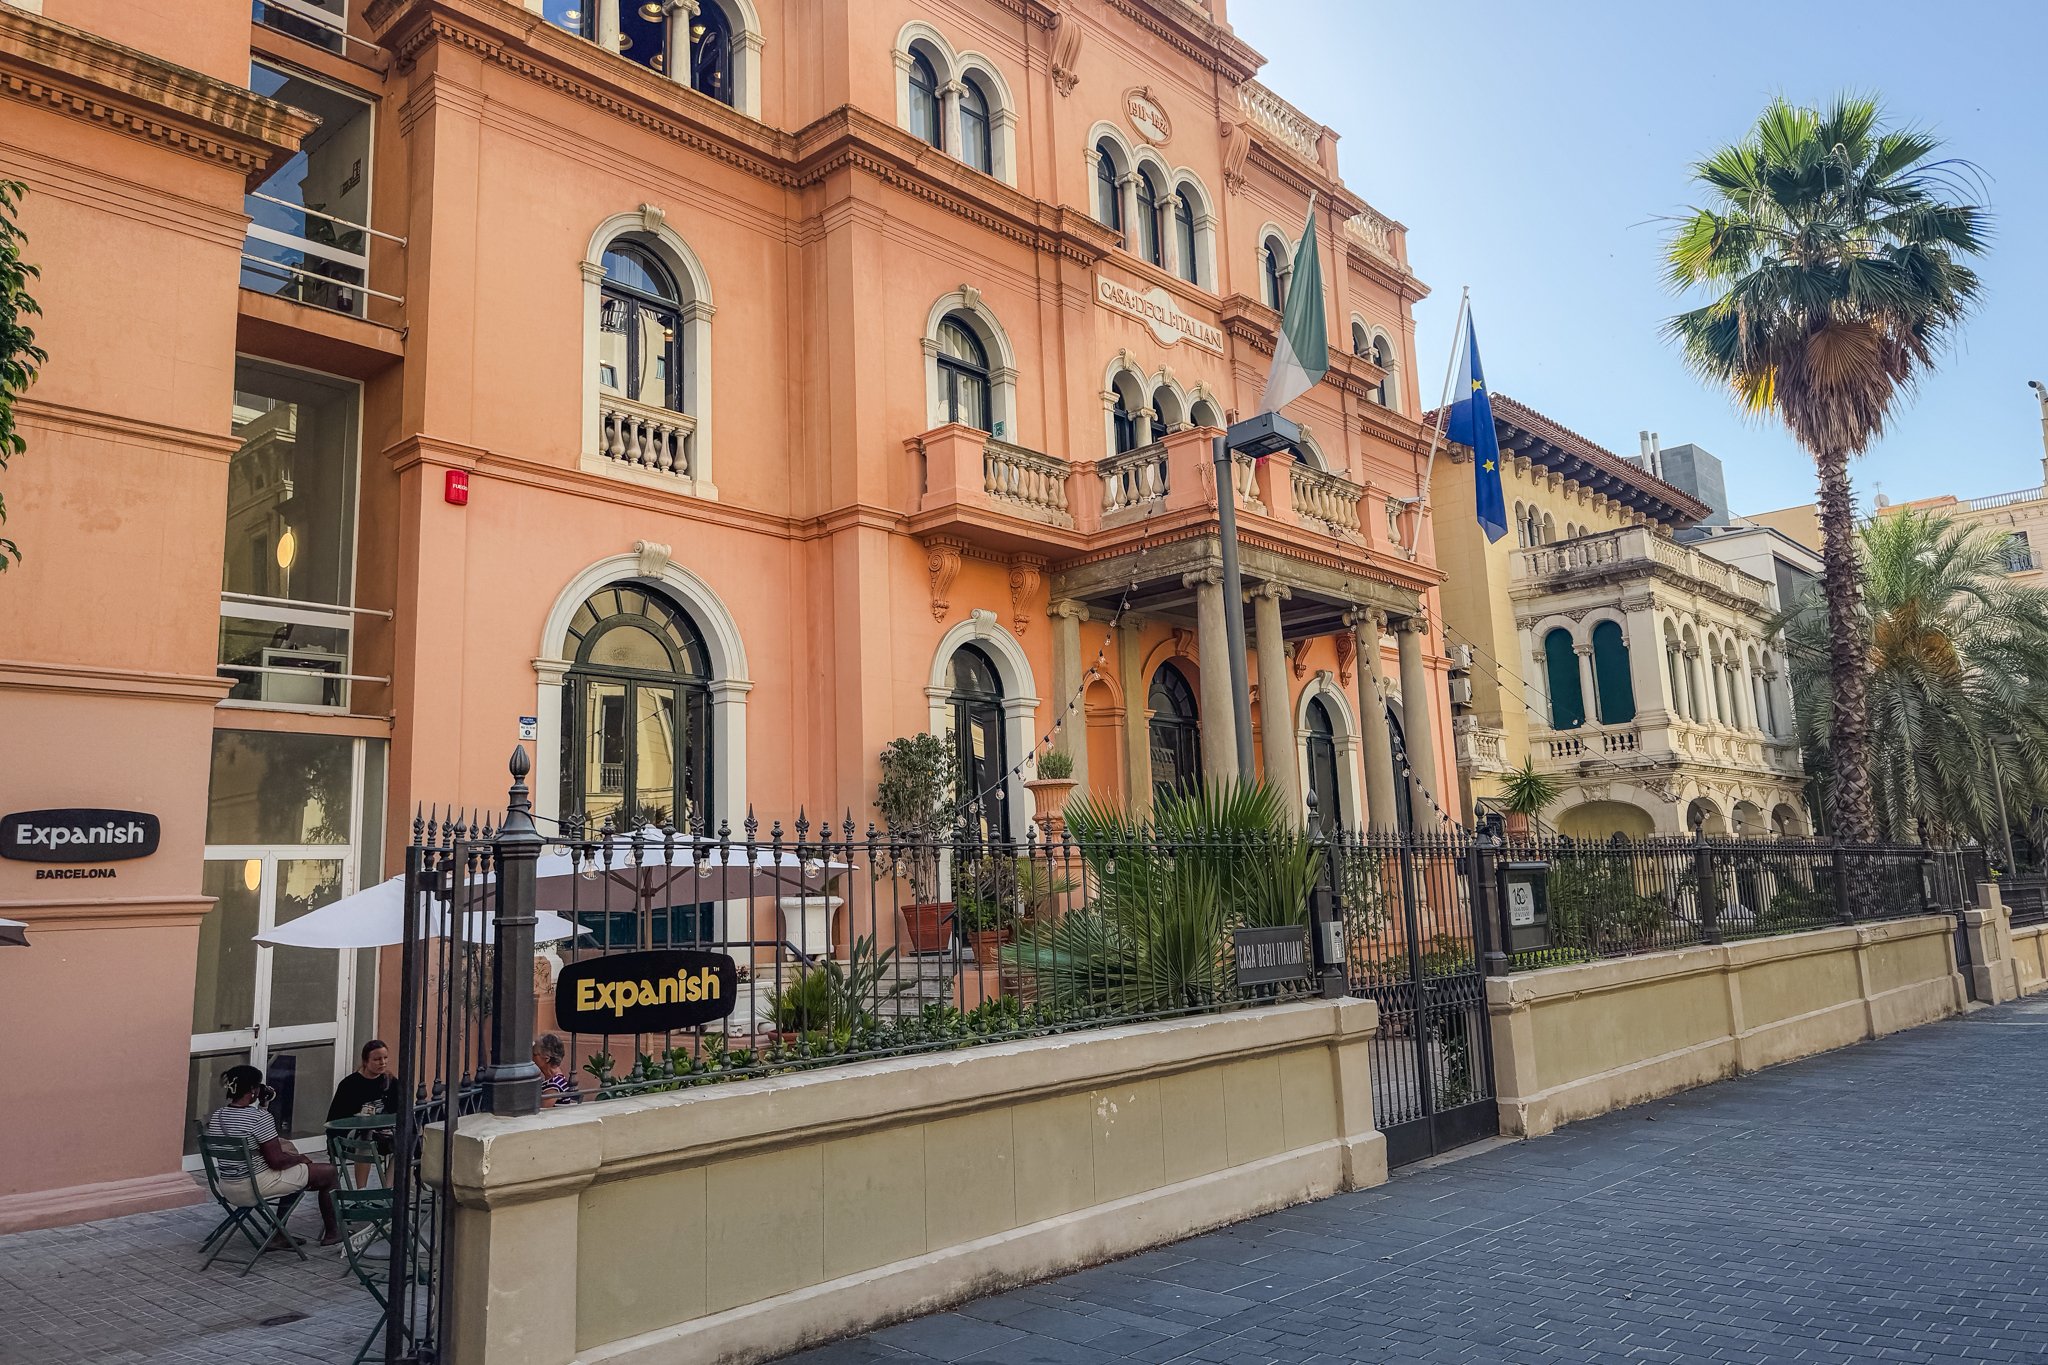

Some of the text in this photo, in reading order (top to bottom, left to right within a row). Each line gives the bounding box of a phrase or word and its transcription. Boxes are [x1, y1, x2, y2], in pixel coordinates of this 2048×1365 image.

[16, 821, 144, 850] Expanish
[36, 868, 117, 880] BARCELONA
[1239, 945, 1256, 970] CASA
[1257, 942, 1276, 968] DEGLI
[577, 966, 720, 1017] Expanish
